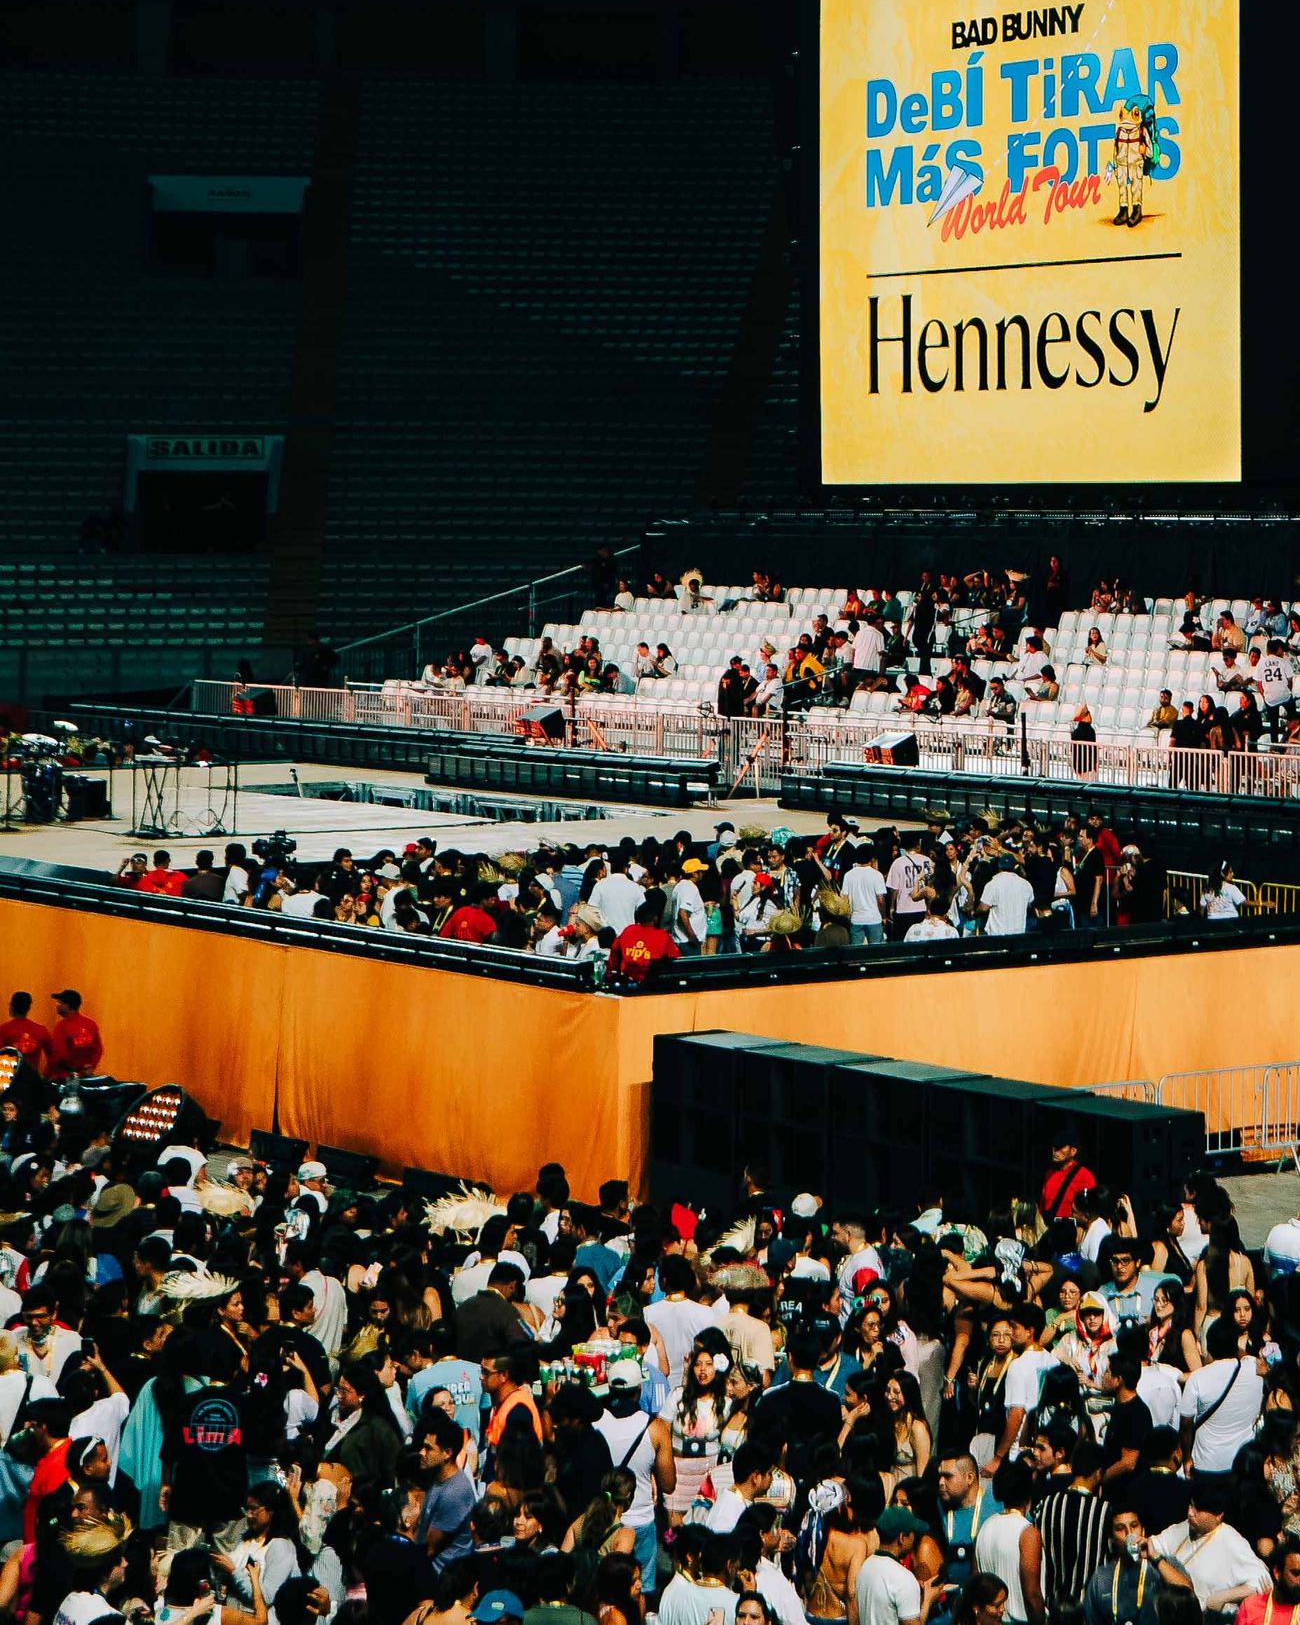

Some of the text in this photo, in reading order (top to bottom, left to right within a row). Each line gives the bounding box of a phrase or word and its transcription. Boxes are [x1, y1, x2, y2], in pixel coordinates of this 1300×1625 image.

[951, 2, 1085, 50] BAD BUNNY
[865, 42, 1182, 140] DeBÍ TiRAR
[1007, 116, 1182, 195] FOTS
[940, 165, 1101, 243] World Tour
[867, 293, 1182, 414] Hennessy
[150, 439, 261, 456] SALIDA
[1264, 667, 1283, 683] 24
